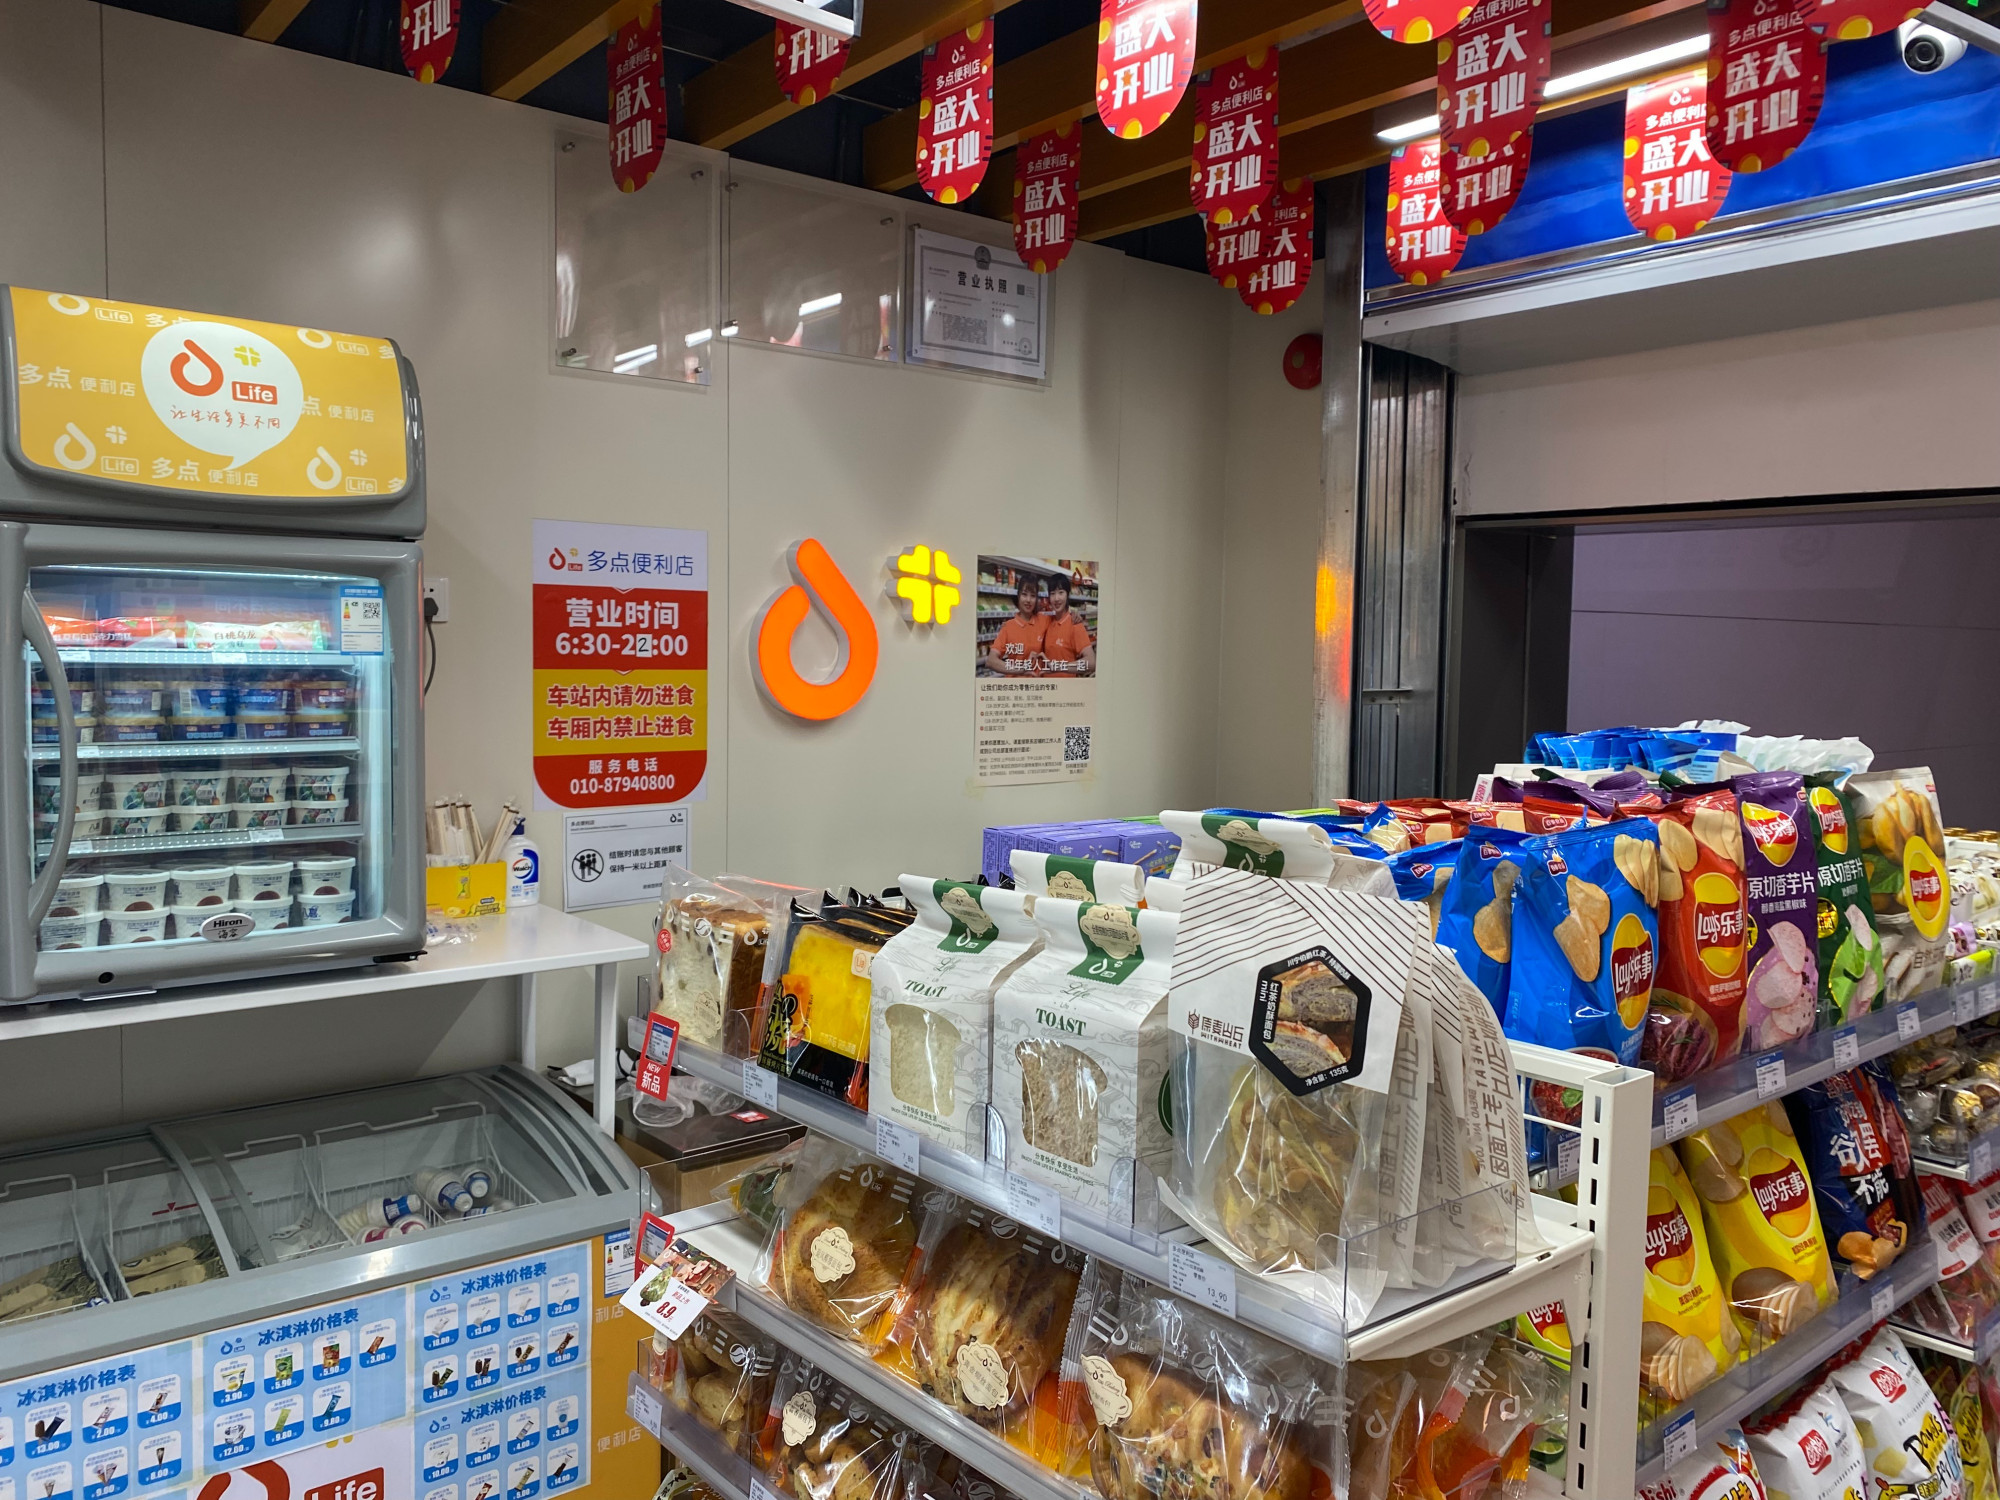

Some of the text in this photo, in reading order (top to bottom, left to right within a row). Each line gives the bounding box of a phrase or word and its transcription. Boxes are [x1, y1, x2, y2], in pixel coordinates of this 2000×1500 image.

[1114, 6, 1176, 62] 盛大
[1729, 11, 1804, 46] 多点便利店
[1456, 23, 1527, 81] 盛大
[936, 59, 980, 90] 多点便利店
[1112, 52, 1173, 110] 开业
[1725, 41, 1801, 98] 盛大
[616, 76, 651, 125] 盛大
[933, 88, 980, 136] 盛大
[1211, 86, 1263, 116] 多点便利店
[1455, 72, 1526, 129] 开业
[1724, 88, 1798, 144] 开业
[616, 118, 653, 167] 开业
[1208, 114, 1263, 159] 盛大
[1642, 127, 1711, 175] 盛大
[930, 130, 980, 177] 开业
[1027, 153, 1067, 174] 多点便利店
[1205, 154, 1261, 199] 开业
[1455, 165, 1512, 210] 开业
[1641, 169, 1709, 215] 开业
[1024, 176, 1066, 213] 盛大
[1024, 213, 1065, 249] 开业
[1399, 225, 1451, 262] 开业
[1217, 229, 1260, 266] 开业
[958, 271, 1007, 294] 营业执照
[1249, 260, 1296, 294] 开业
[99, 310, 130, 323] Life
[340, 342, 368, 355] Life
[19, 365, 136, 397] 多点 便利店
[235, 383, 274, 402] Life
[328, 404, 374, 423] 便利店
[104, 458, 136, 473] Life
[152, 457, 258, 487] 多点 便利店
[587, 549, 694, 577] 多点便利店
[566, 597, 679, 630] 营业时间
[214, 631, 256, 640] 白桃乌龙
[555, 632, 688, 657] 6:30-22:00
[1005, 643, 1024, 655] 欢迎
[547, 684, 695, 708] 车站内请勿进食
[547, 715, 695, 740] 车厢内禁止进食
[588, 758, 658, 775] 服务电话
[570, 774, 675, 795] 010-87940800
[609, 845, 683, 859] 结账时请您与其他顾客
[1747, 871, 1815, 900] 原切香芋片
[1818, 858, 1864, 887] 原切香芋片
[213, 917, 243, 928] Hiron
[218, 928, 238, 940] 海容
[1697, 909, 1743, 944] Lay's 乐事
[1614, 950, 1653, 994] Lay's 乐事
[904, 980, 947, 997] TOAST
[1260, 980, 1268, 1002] mini
[1036, 1008, 1086, 1036] TOAST
[1263, 982, 1279, 1040] 红茶奶酥面包
[1201, 1032, 1241, 1049] WITHWHEAT
[641, 1071, 661, 1095] 新品
[646, 1062, 661, 1073] NEW
[1754, 1171, 1806, 1212] Lay's 乐事
[1850, 1168, 1889, 1205] 不能
[1670, 1214, 1688, 1246] 乐事
[461, 1262, 547, 1295] 冰淇淋价格表
[1065, 1262, 1080, 1272] Life
[656, 1301, 677, 1319] 8.9
[1207, 1287, 1228, 1302] 13.90
[258, 1308, 359, 1346] 冰淇淋价格表
[1130, 1342, 1144, 1352] Life
[17, 1364, 136, 1408] 冰淇淋价格表
[461, 1386, 547, 1424] 冰淇淋价格表
[597, 1427, 642, 1453] 便利店
